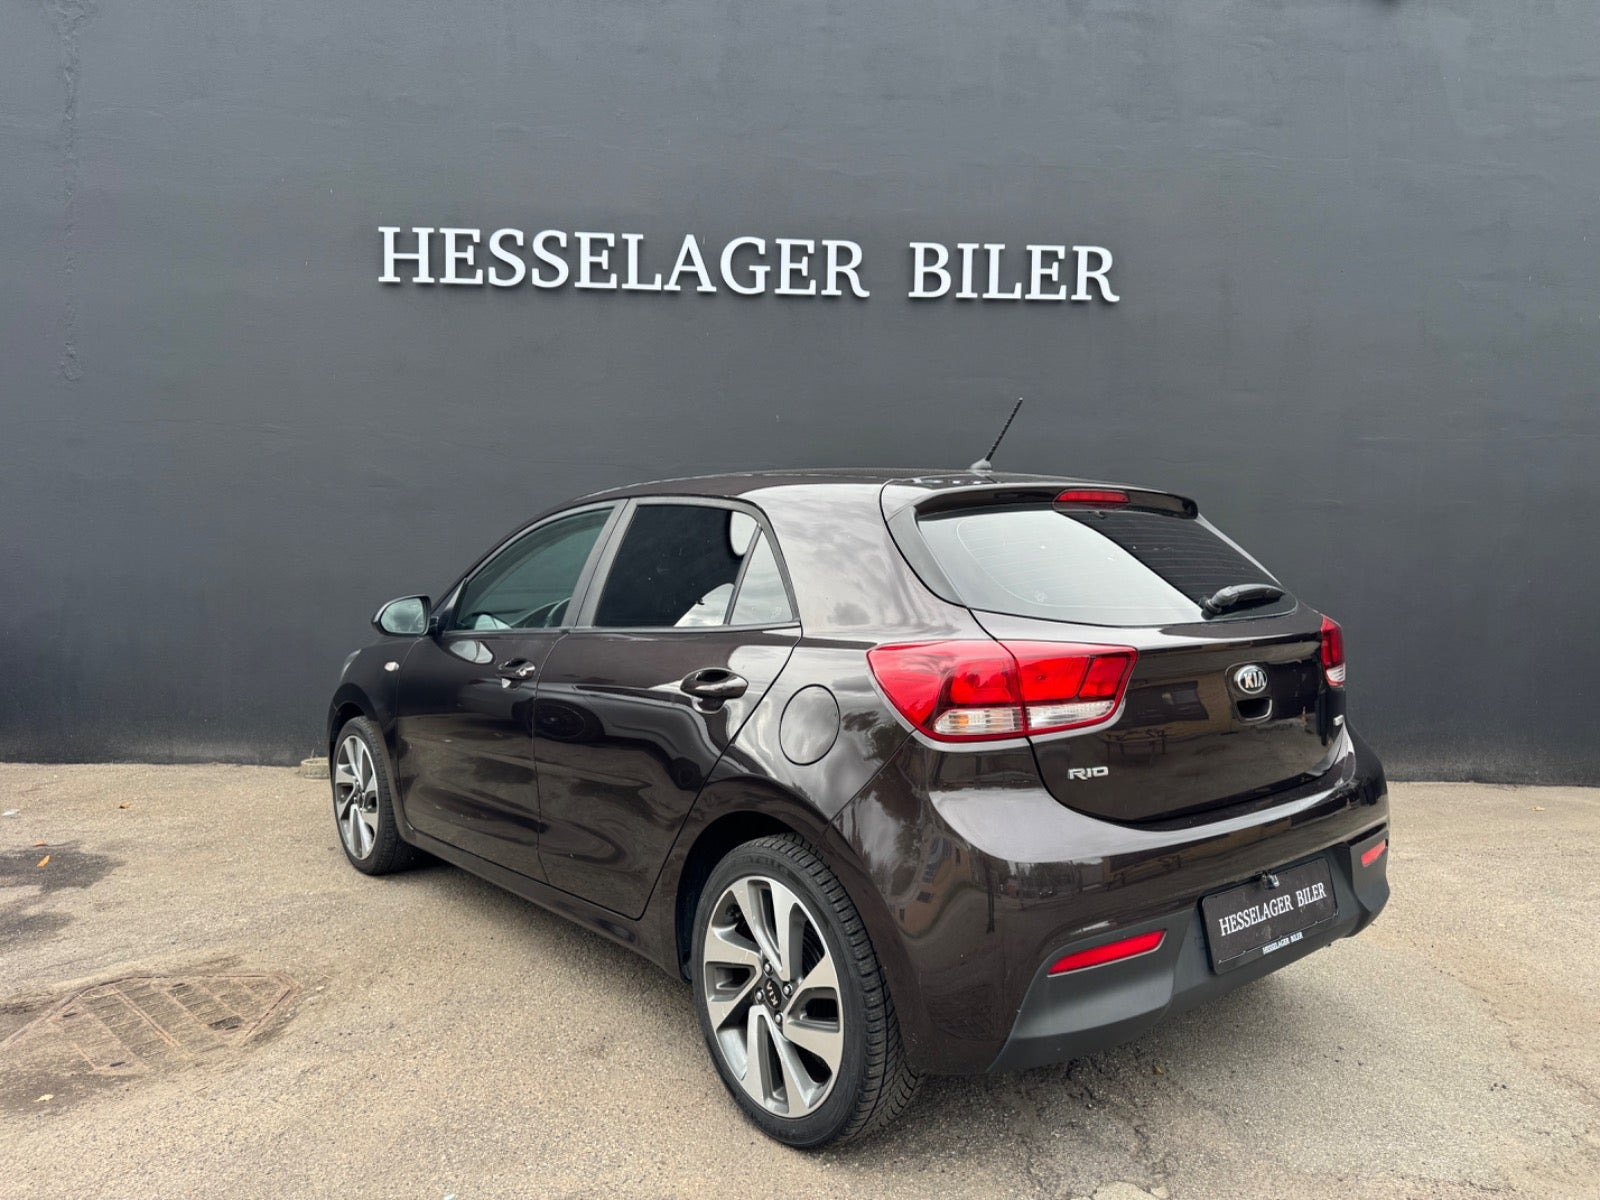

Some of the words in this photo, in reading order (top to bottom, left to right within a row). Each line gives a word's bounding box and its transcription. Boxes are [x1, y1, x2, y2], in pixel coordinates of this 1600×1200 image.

[378, 226, 869, 298] HESSELAGER
[908, 241, 1120, 302] BILER
[1244, 671, 1266, 689] KIA
[1068, 766, 1108, 781] RIO
[1218, 894, 1294, 936] HESSELAGER
[1296, 882, 1327, 907] BILER
